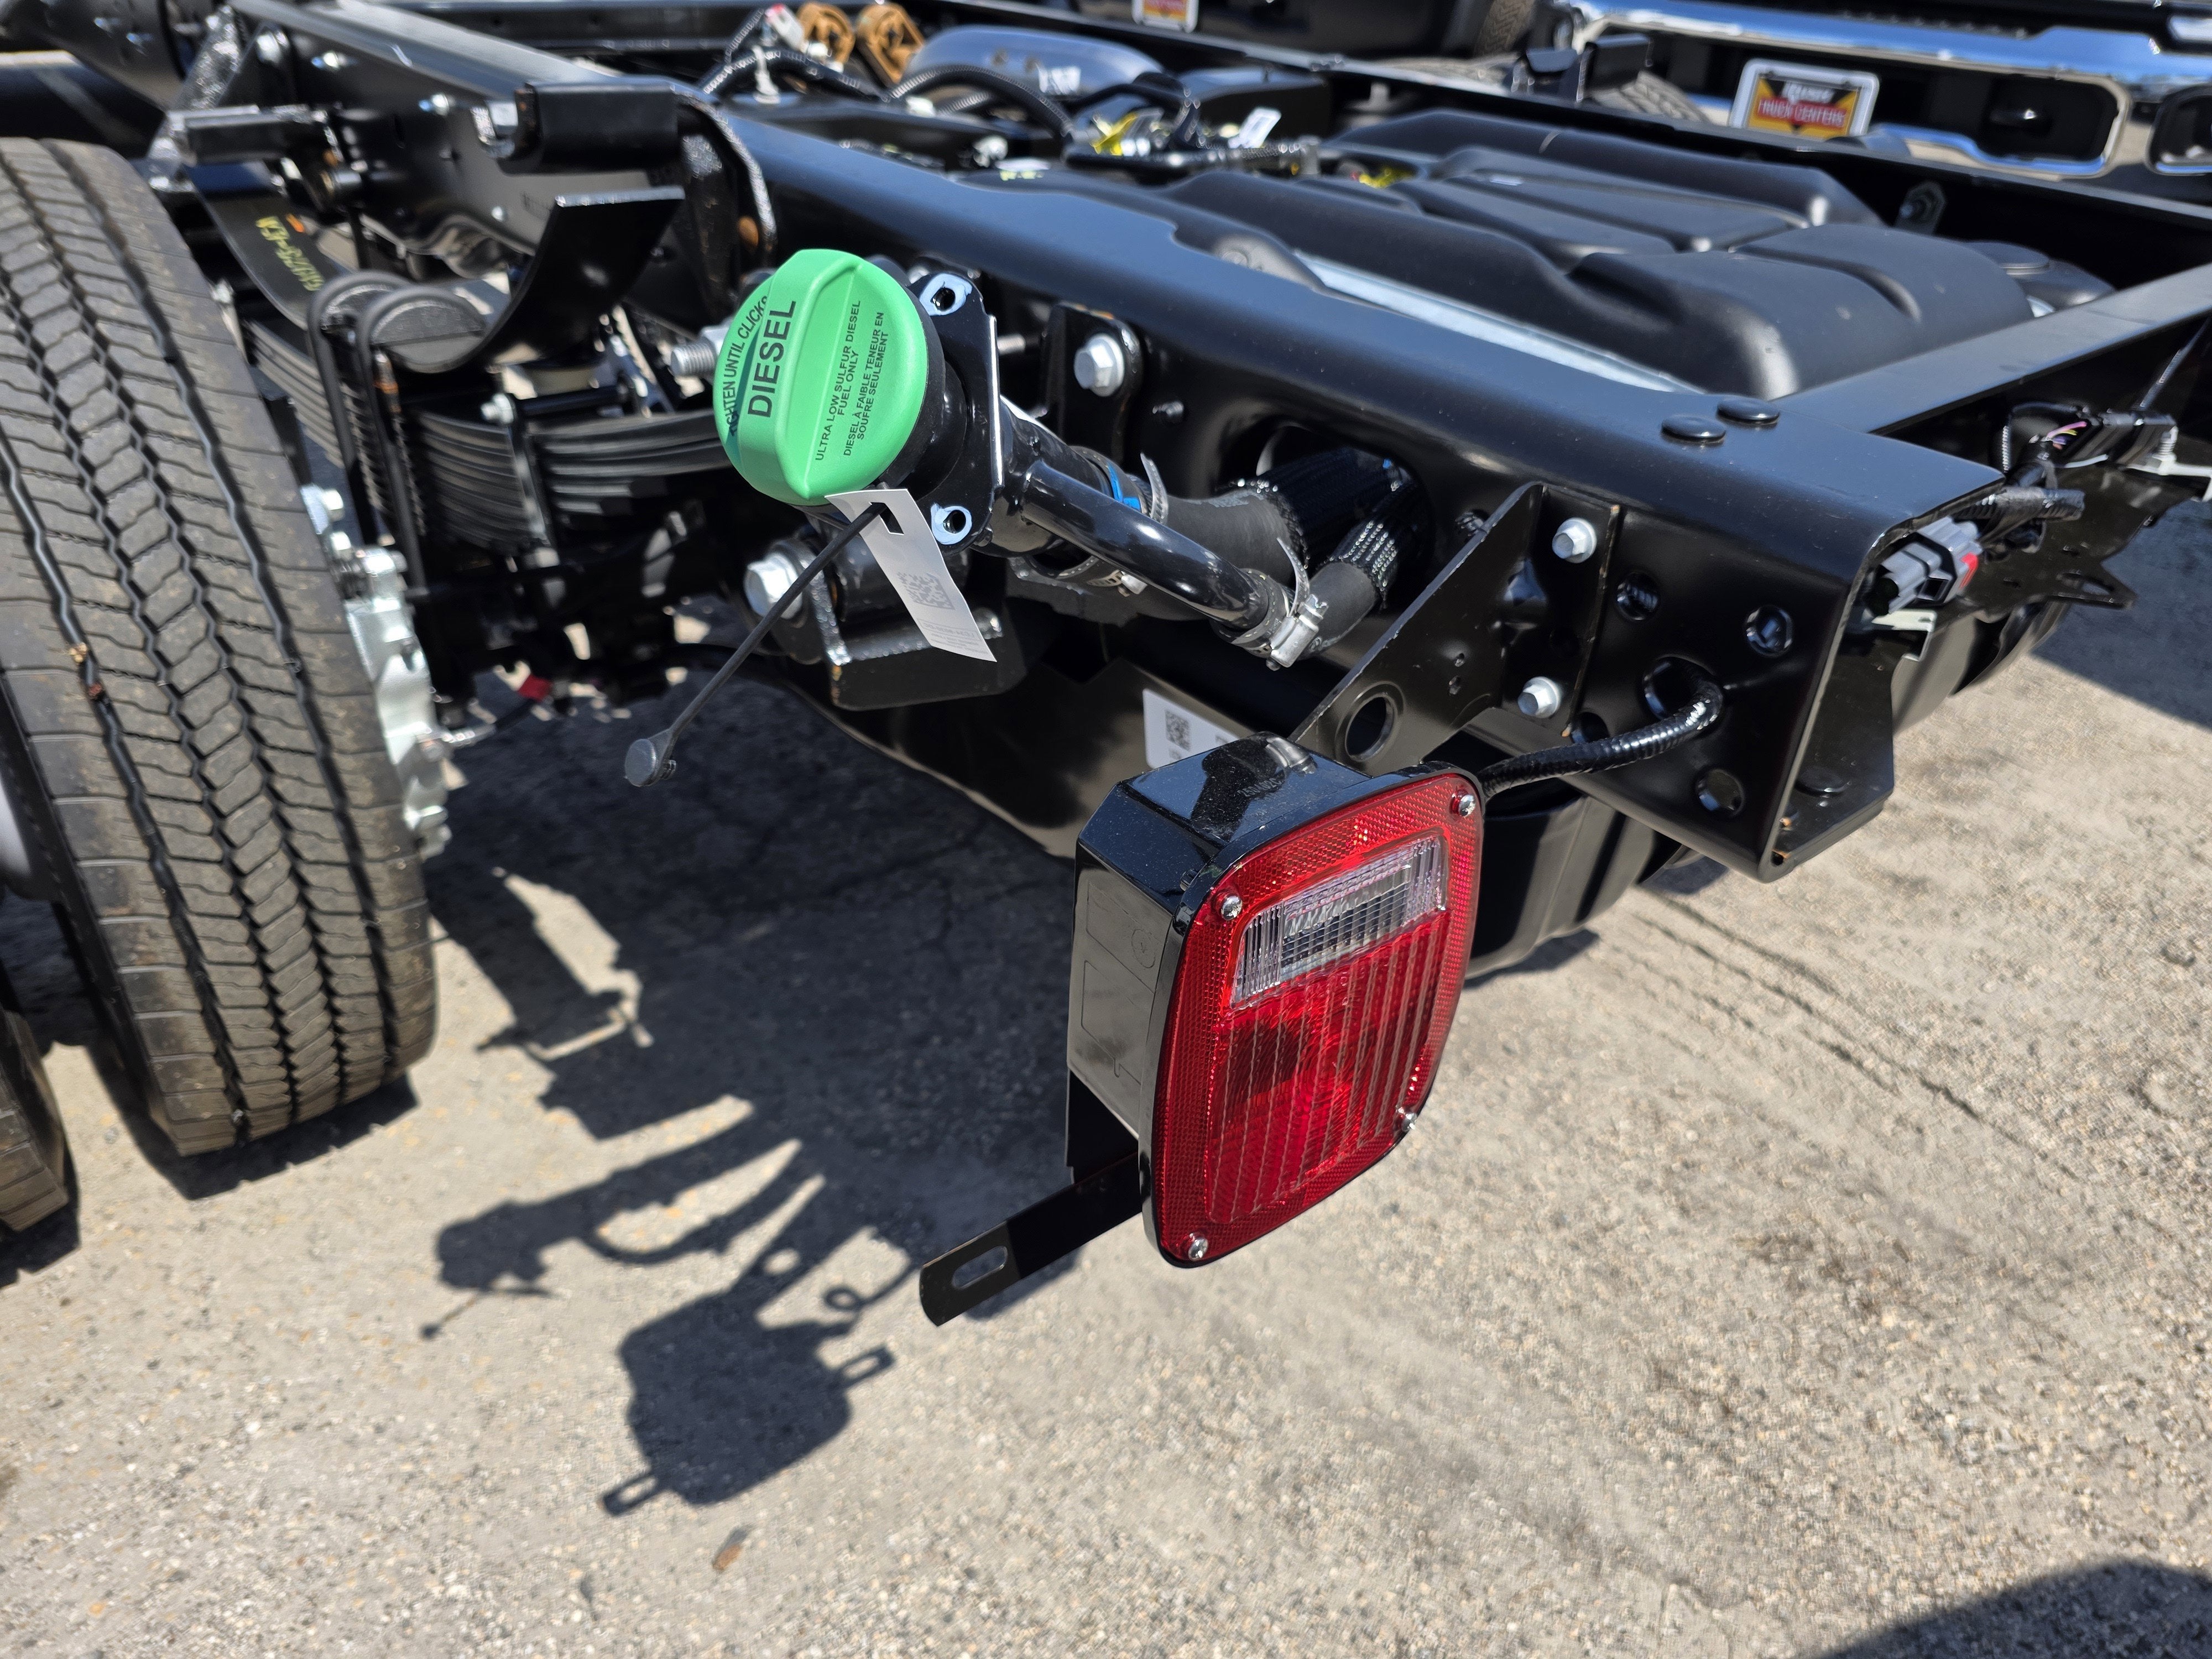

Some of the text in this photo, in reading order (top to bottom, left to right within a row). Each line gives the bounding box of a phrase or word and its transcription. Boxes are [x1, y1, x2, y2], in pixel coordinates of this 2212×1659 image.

[723, 342, 745, 378] UNTIL
[747, 300, 797, 418] DIESEL
[815, 300, 861, 461] ULTRA LOW SULFUR DIESEL
[837, 350, 859, 416] FUEL ONLY
[843, 421, 860, 456] DIESEL
[856, 373, 872, 409] FAIBLE
[865, 329, 881, 371] TENEUR
[874, 312, 884, 327] EN
[857, 331, 889, 440] SOUFRE SEULEMENT
